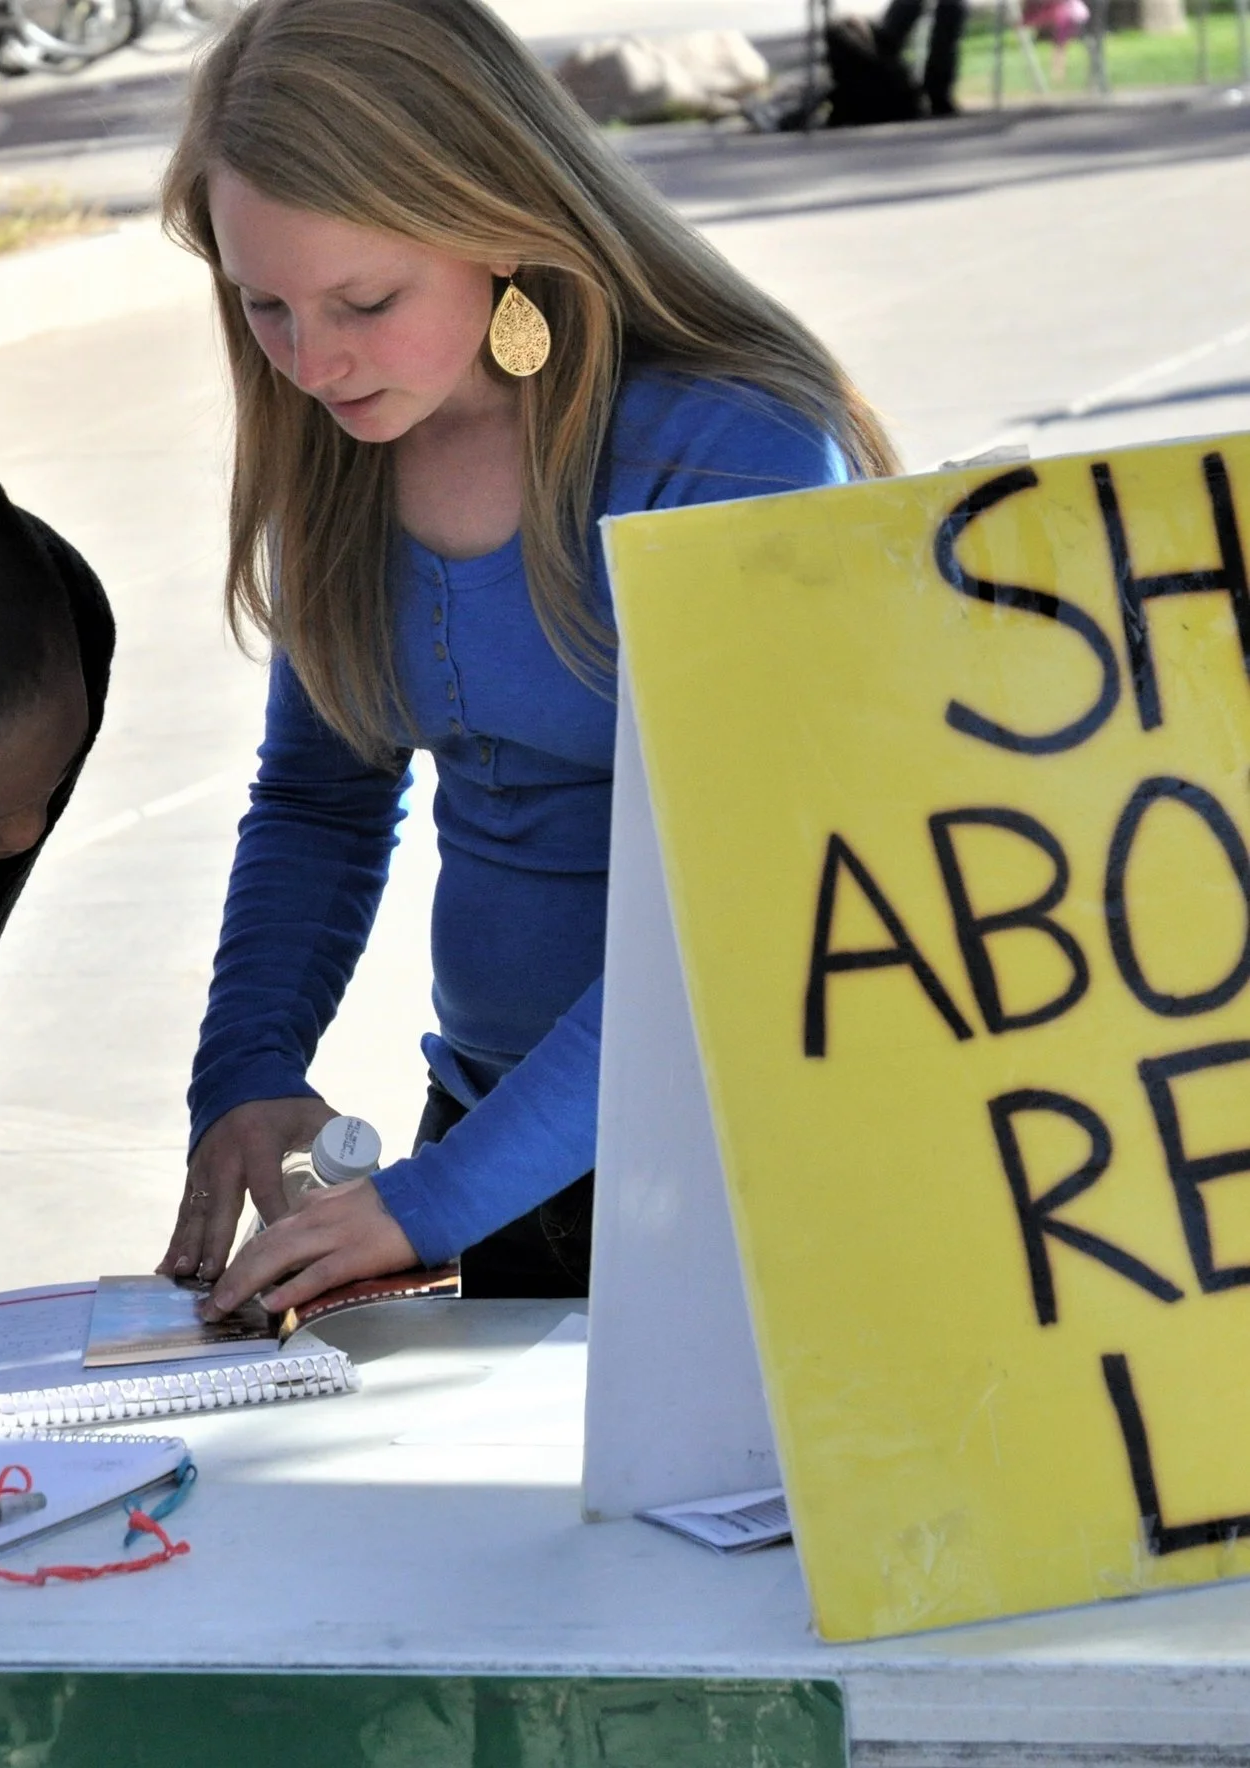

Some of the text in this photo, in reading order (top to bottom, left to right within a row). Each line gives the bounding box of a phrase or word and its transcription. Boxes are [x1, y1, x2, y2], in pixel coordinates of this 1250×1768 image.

[933, 450, 1250, 755] SH
[802, 775, 1250, 1059] ABO
[987, 1039, 1250, 1327] RE
